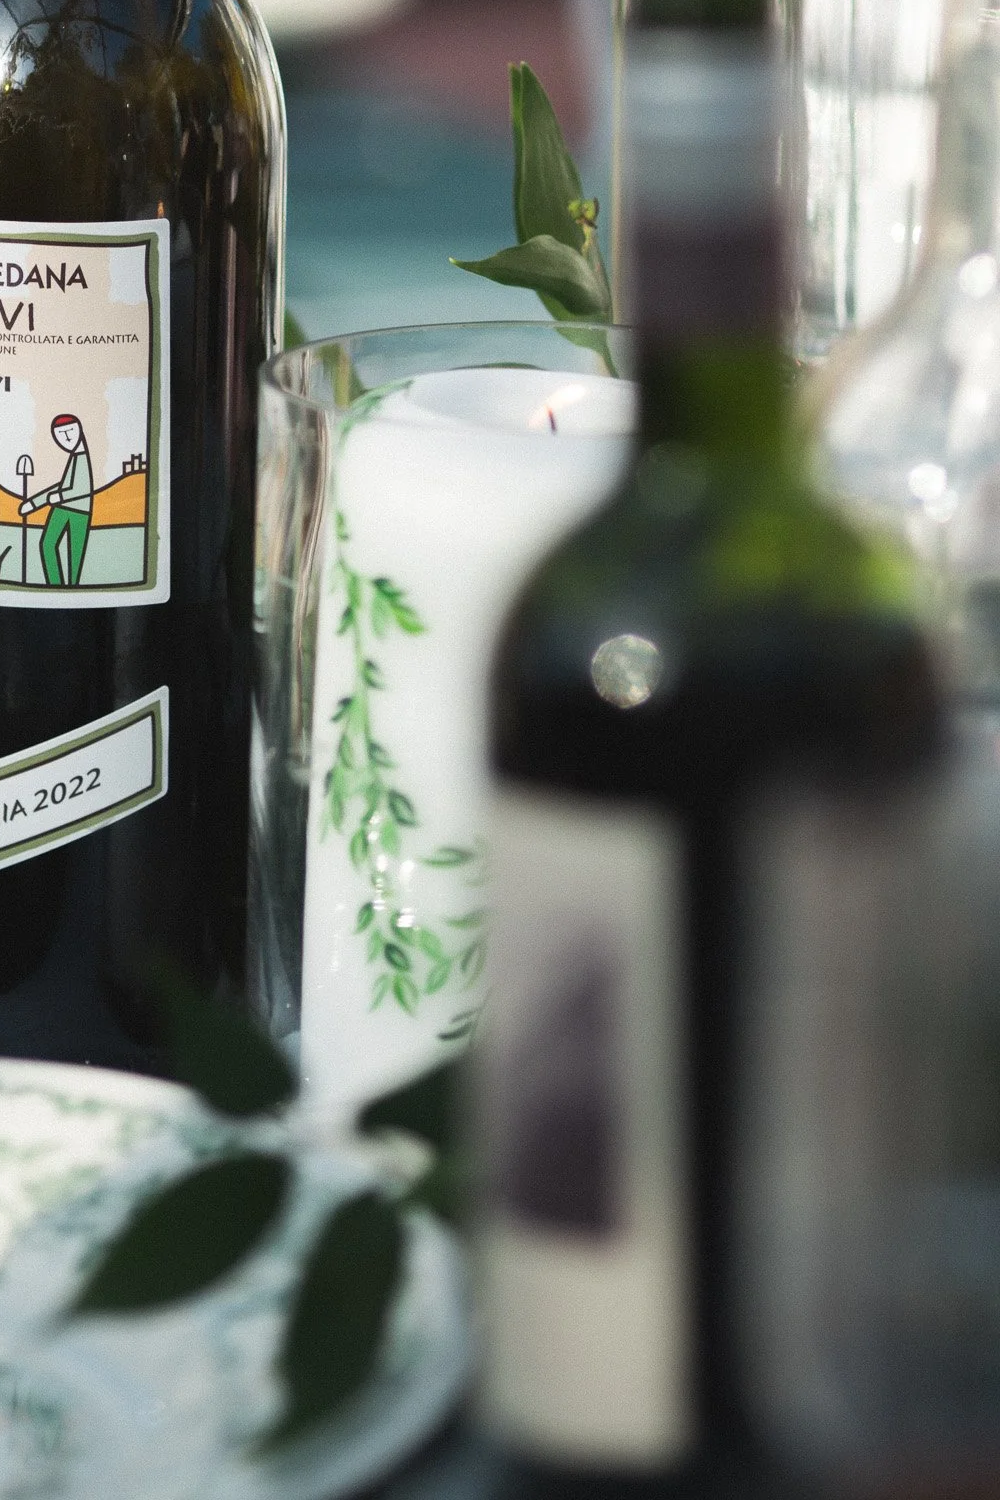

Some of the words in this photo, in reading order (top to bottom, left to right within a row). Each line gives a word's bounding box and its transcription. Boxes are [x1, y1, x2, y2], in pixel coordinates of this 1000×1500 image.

[67, 335, 73, 345] E
[76, 333, 139, 345] GARANTITA
[33, 767, 102, 813] 2022
